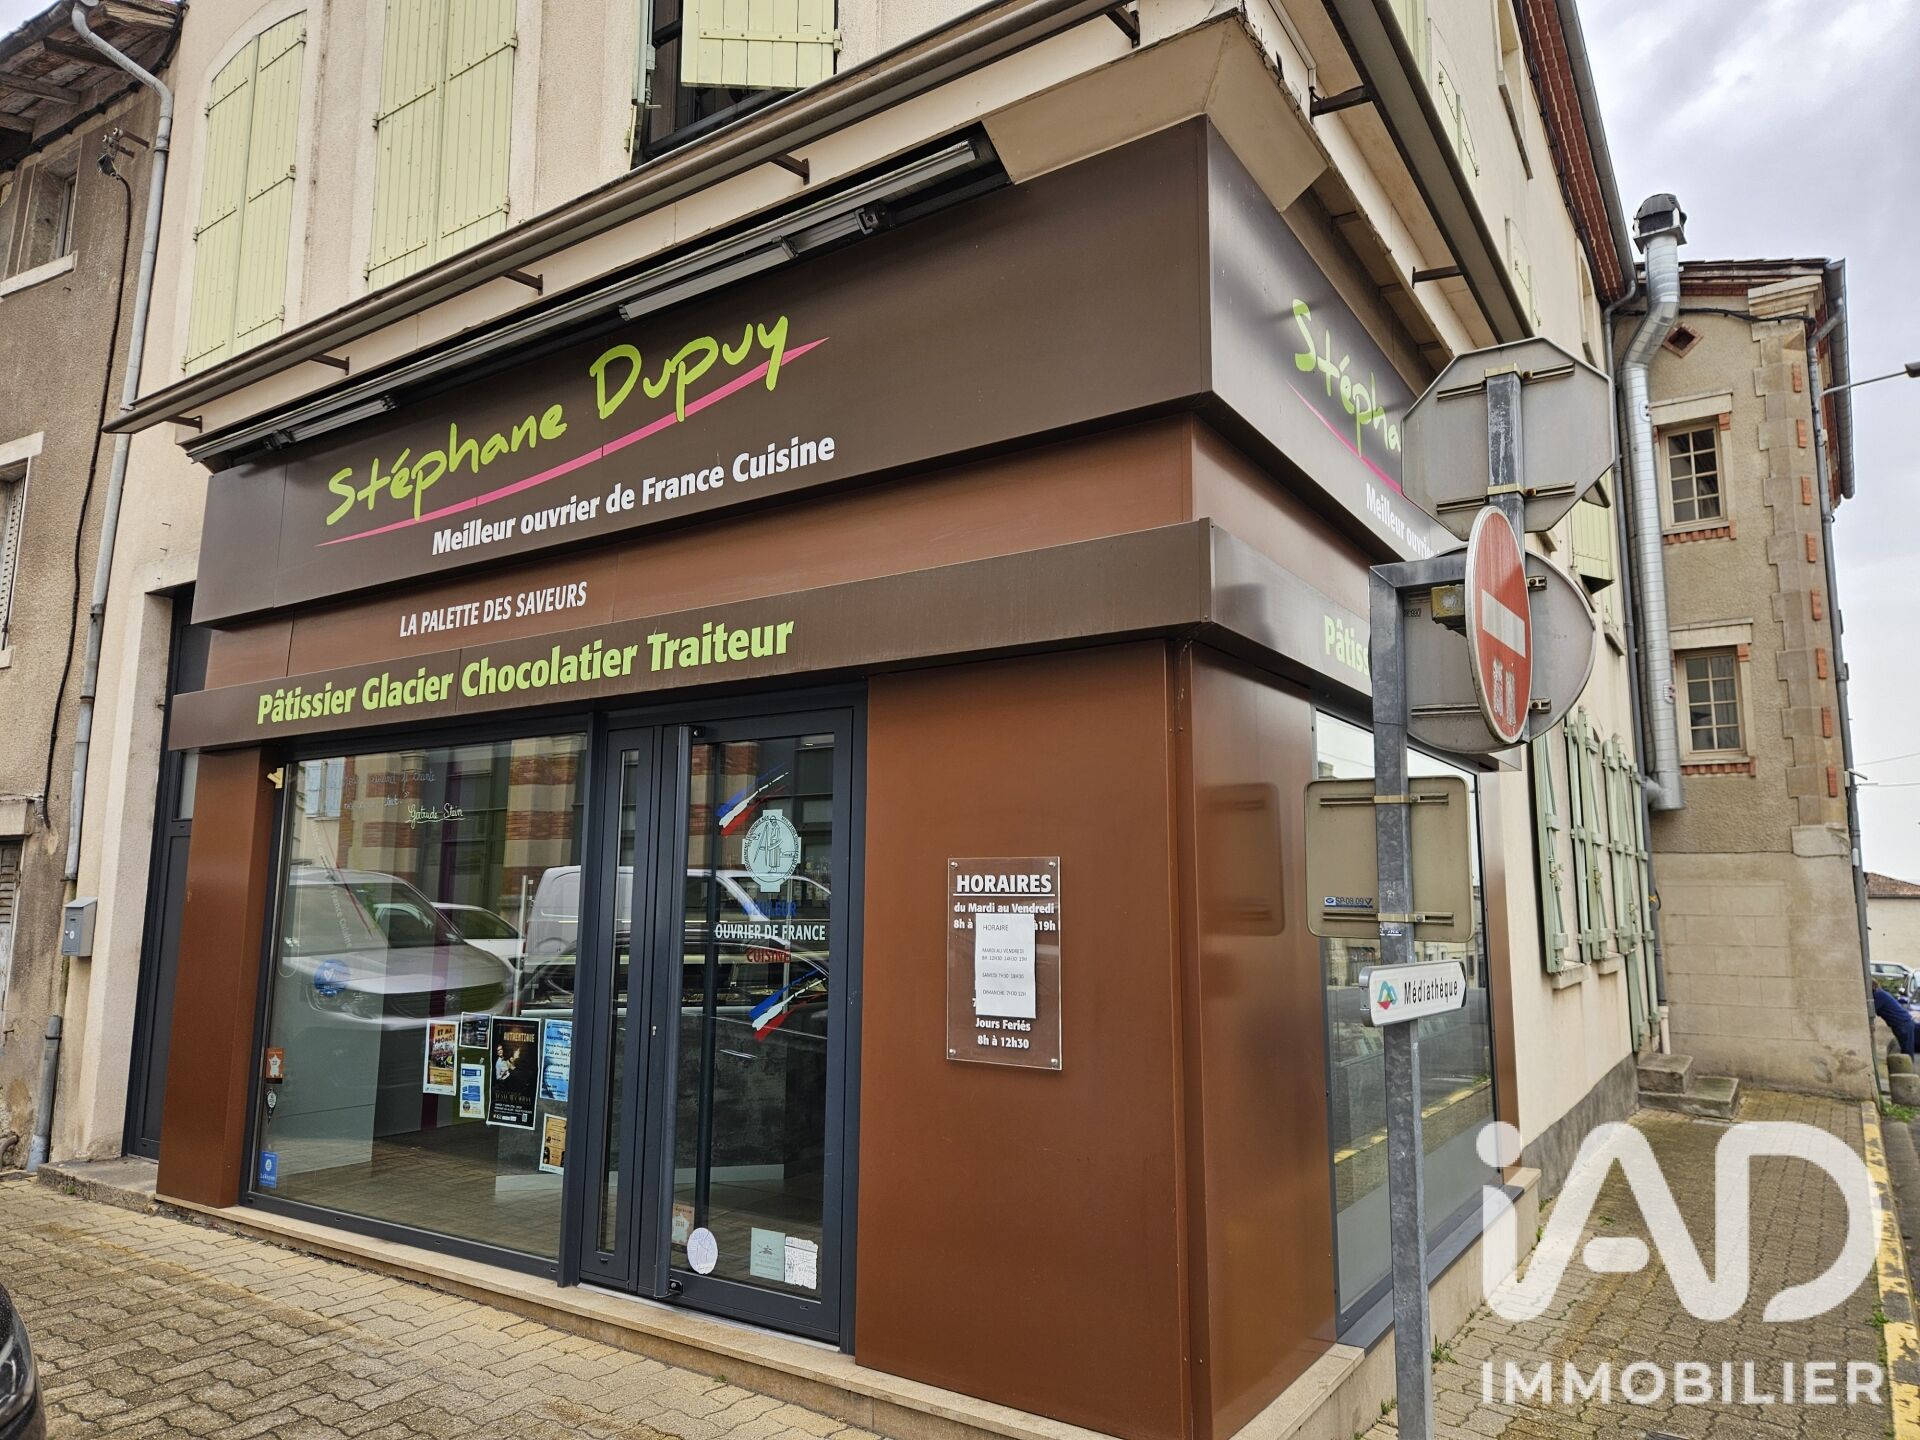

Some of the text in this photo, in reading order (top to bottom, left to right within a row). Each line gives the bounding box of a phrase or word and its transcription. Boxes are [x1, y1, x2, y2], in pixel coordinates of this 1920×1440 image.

[325, 315, 789, 526] Stéphane Dupuy
[432, 437, 836, 556] Meilleur ouvrier de France Cuisine
[1366, 482, 1405, 541] Meilleur
[400, 581, 588, 638] LA PALETTE DES SAVEURS
[257, 617, 795, 725] Pâtissier Glacier Chocolatier Traiteur
[956, 874, 1053, 893] HORAIRES
[954, 902, 1055, 914] du Mardi au Vendredi
[714, 923, 826, 941] OUVRIER DE FRANCE
[953, 919, 965, 929] 8h
[967, 919, 973, 930] à
[982, 924, 1009, 932] HORAIRE
[746, 948, 792, 964] CUISINE
[1404, 978, 1458, 1004] Médiathèque
[976, 1017, 1032, 1032] Jours Feriés
[977, 1034, 1030, 1050] 8h à 12h30
